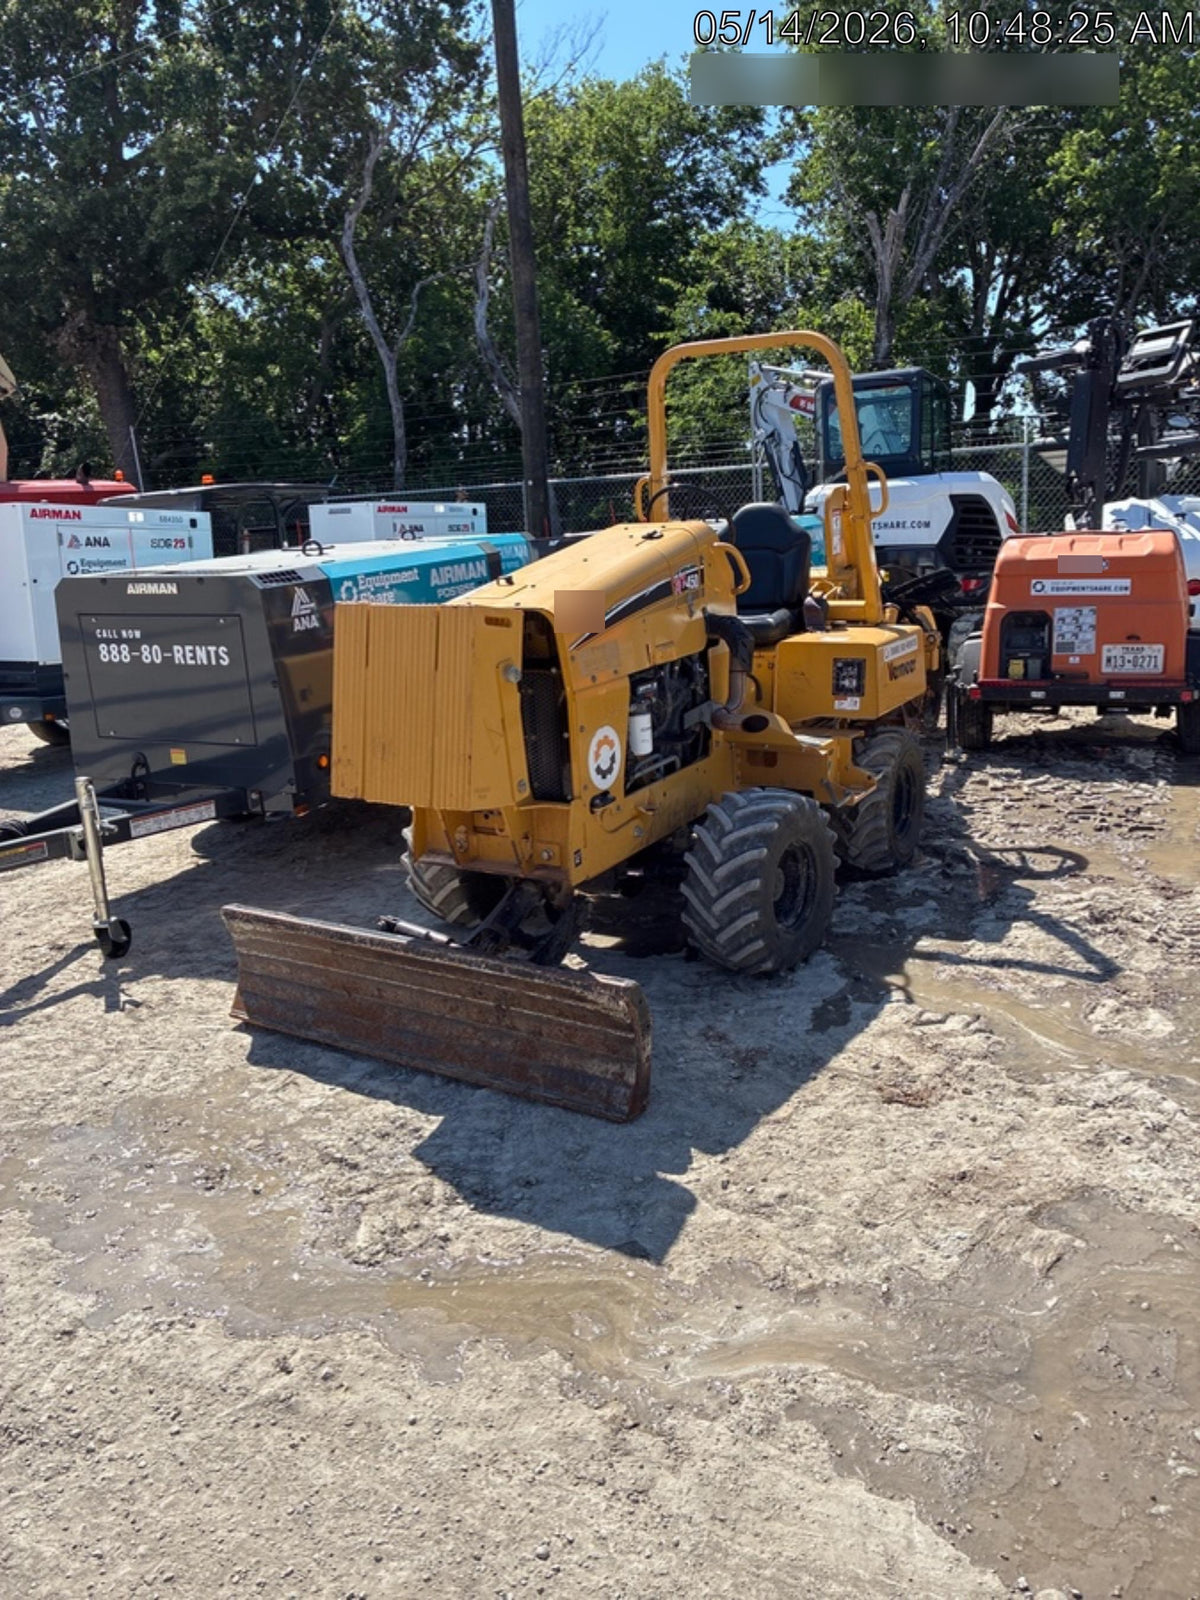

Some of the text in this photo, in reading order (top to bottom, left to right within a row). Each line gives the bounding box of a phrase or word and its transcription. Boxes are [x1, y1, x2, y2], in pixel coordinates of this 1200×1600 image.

[30, 508, 81, 520] AIRMAN
[84, 536, 111, 548] ANA
[80, 558, 127, 571] Equipment
[357, 567, 420, 590] Equipment
[430, 560, 487, 587] AIRMAN
[127, 583, 178, 595] AIRMAN
[293, 614, 320, 632] ANA
[96, 629, 141, 639] CALL NOW
[98, 642, 230, 666] 888-80-RENTS
